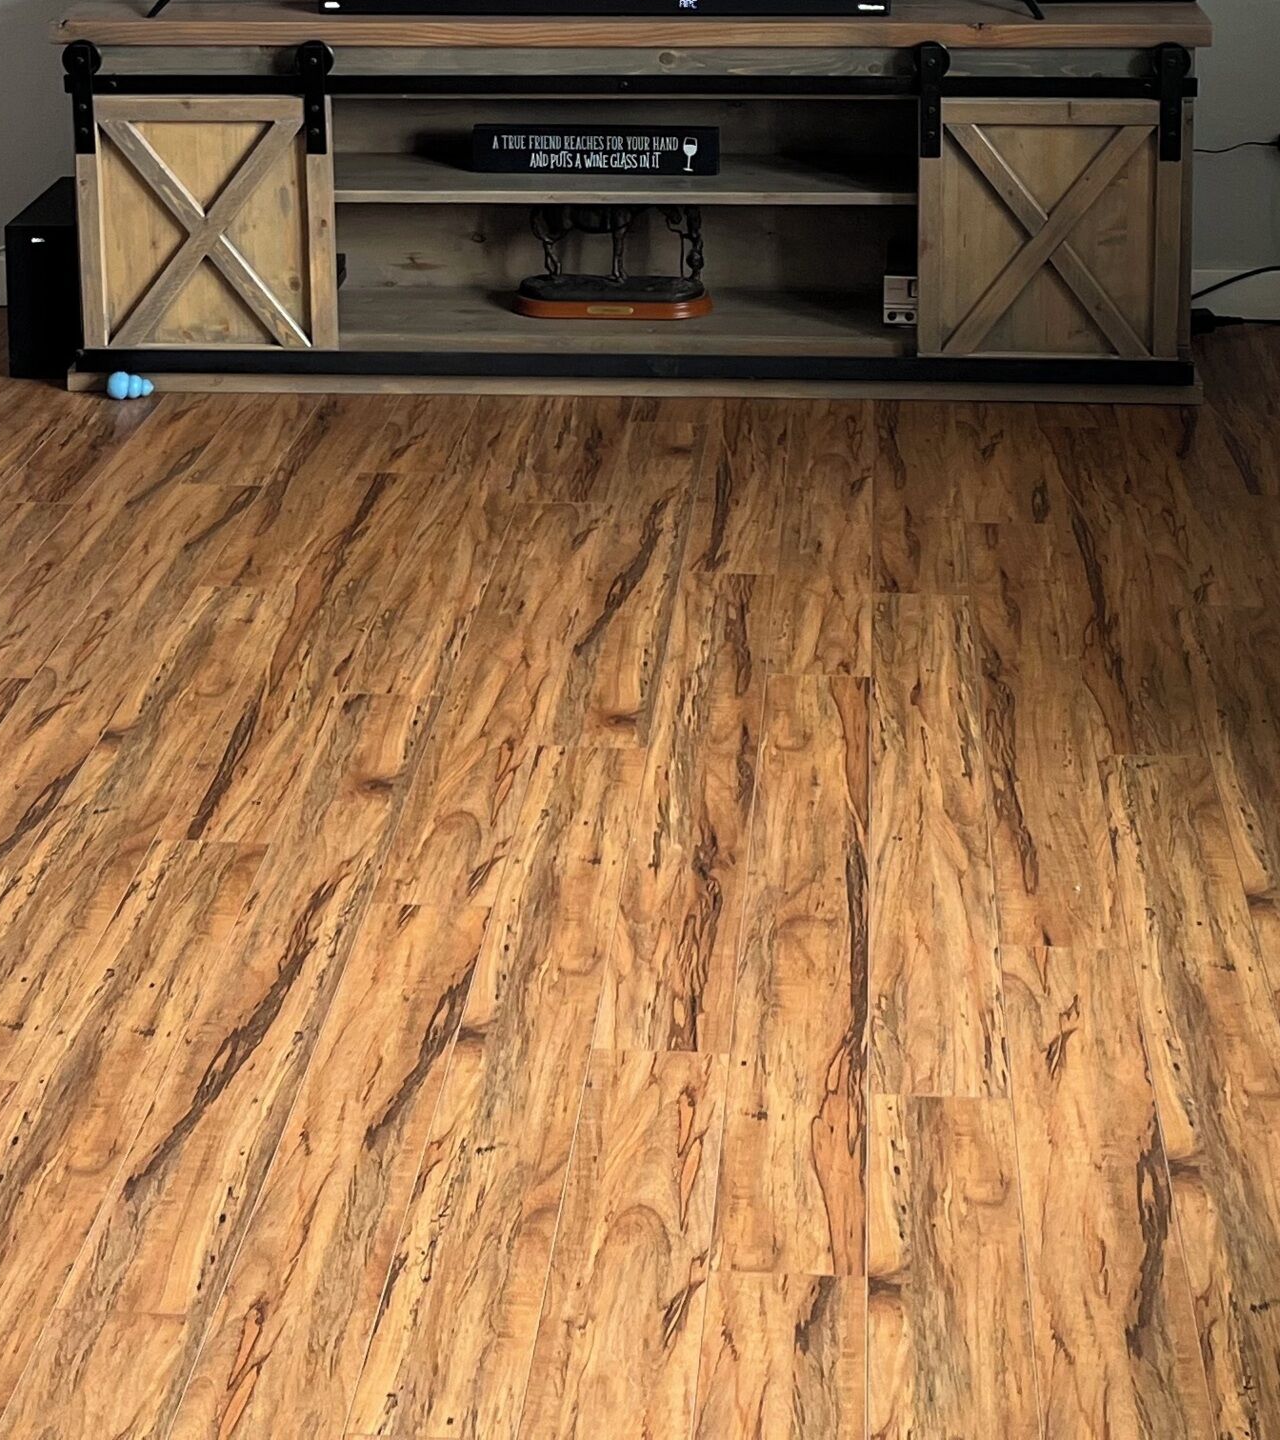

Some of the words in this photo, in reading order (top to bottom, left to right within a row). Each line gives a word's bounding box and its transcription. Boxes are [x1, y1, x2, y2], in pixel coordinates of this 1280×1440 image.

[492, 135, 499, 150] A
[501, 135, 526, 150] TRUE
[529, 135, 561, 150] FRIEND
[564, 135, 604, 151] REACHES
[607, 136, 624, 151] FOR
[626, 136, 650, 151] YOUR
[653, 136, 679, 151] HAND
[529, 151, 549, 168] AND
[551, 151, 573, 169] PUTS
[575, 152, 582, 169] A
[583, 151, 609, 168] WINE
[610, 152, 638, 169] GLASS
